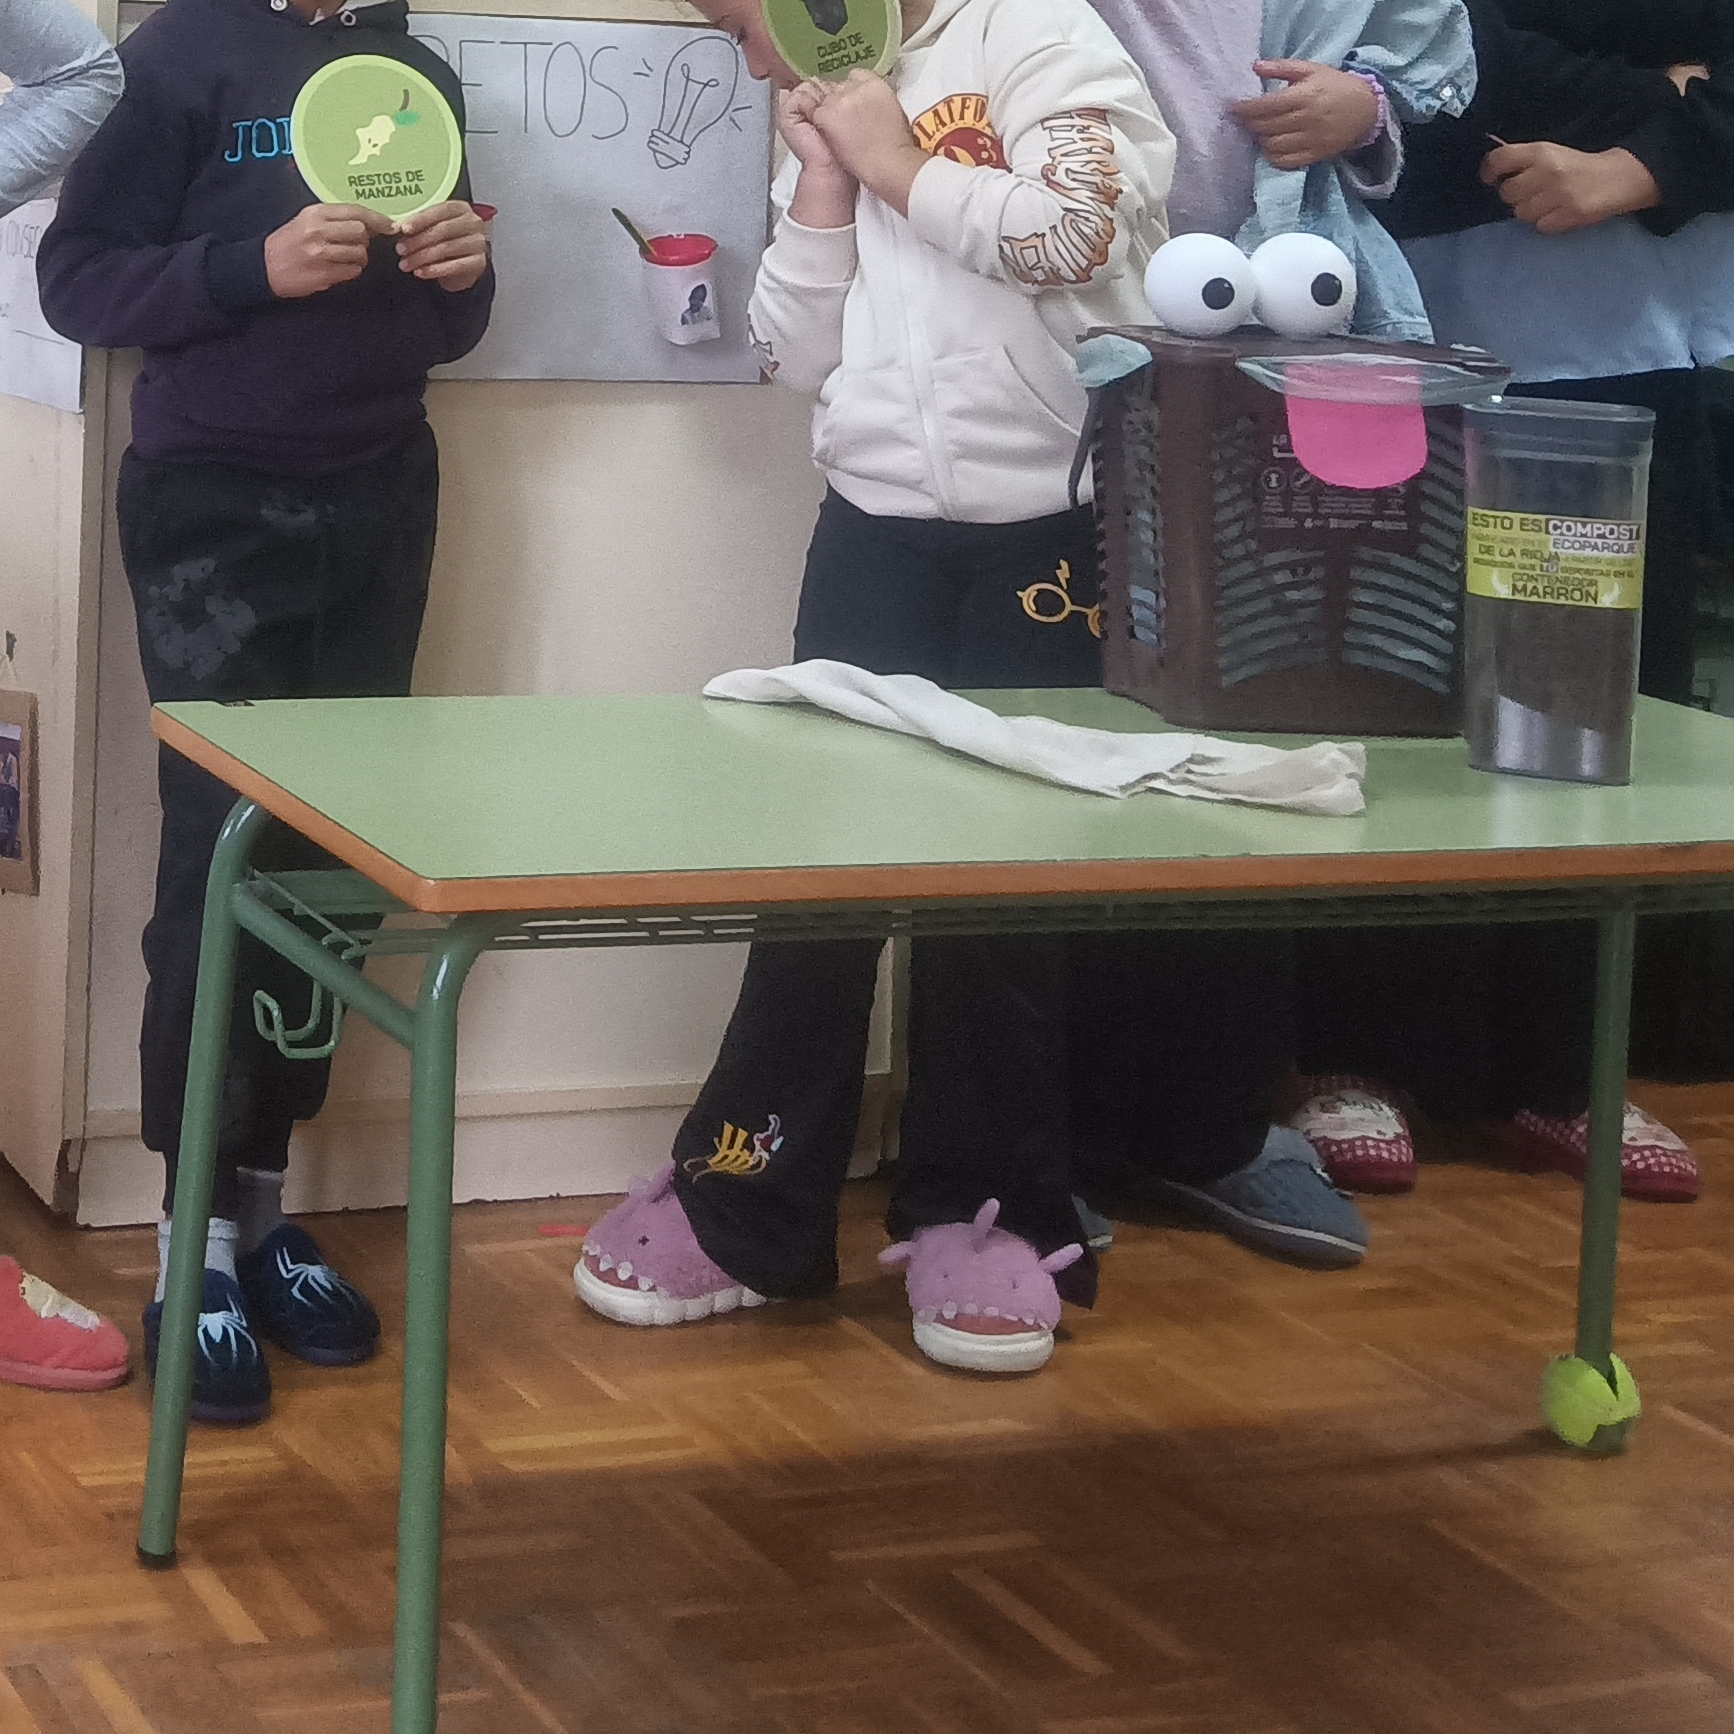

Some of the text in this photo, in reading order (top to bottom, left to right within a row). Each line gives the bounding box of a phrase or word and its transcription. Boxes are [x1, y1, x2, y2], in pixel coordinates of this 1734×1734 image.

[816, 31, 865, 59] CUBO DE
[817, 45, 877, 74] RECICLAJE
[412, 34, 630, 140] ETOS
[347, 169, 426, 188] RESTOS DE
[354, 183, 424, 201] MANZANA
[1471, 511, 1514, 531] ESTO
[1519, 517, 1543, 534] ES
[1547, 519, 1640, 541] COMPOST
[1478, 543, 1495, 557] DE
[1498, 546, 1516, 559] LA
[1520, 548, 1561, 563] RIOJA
[1552, 538, 1637, 555] ECOPARQUE
